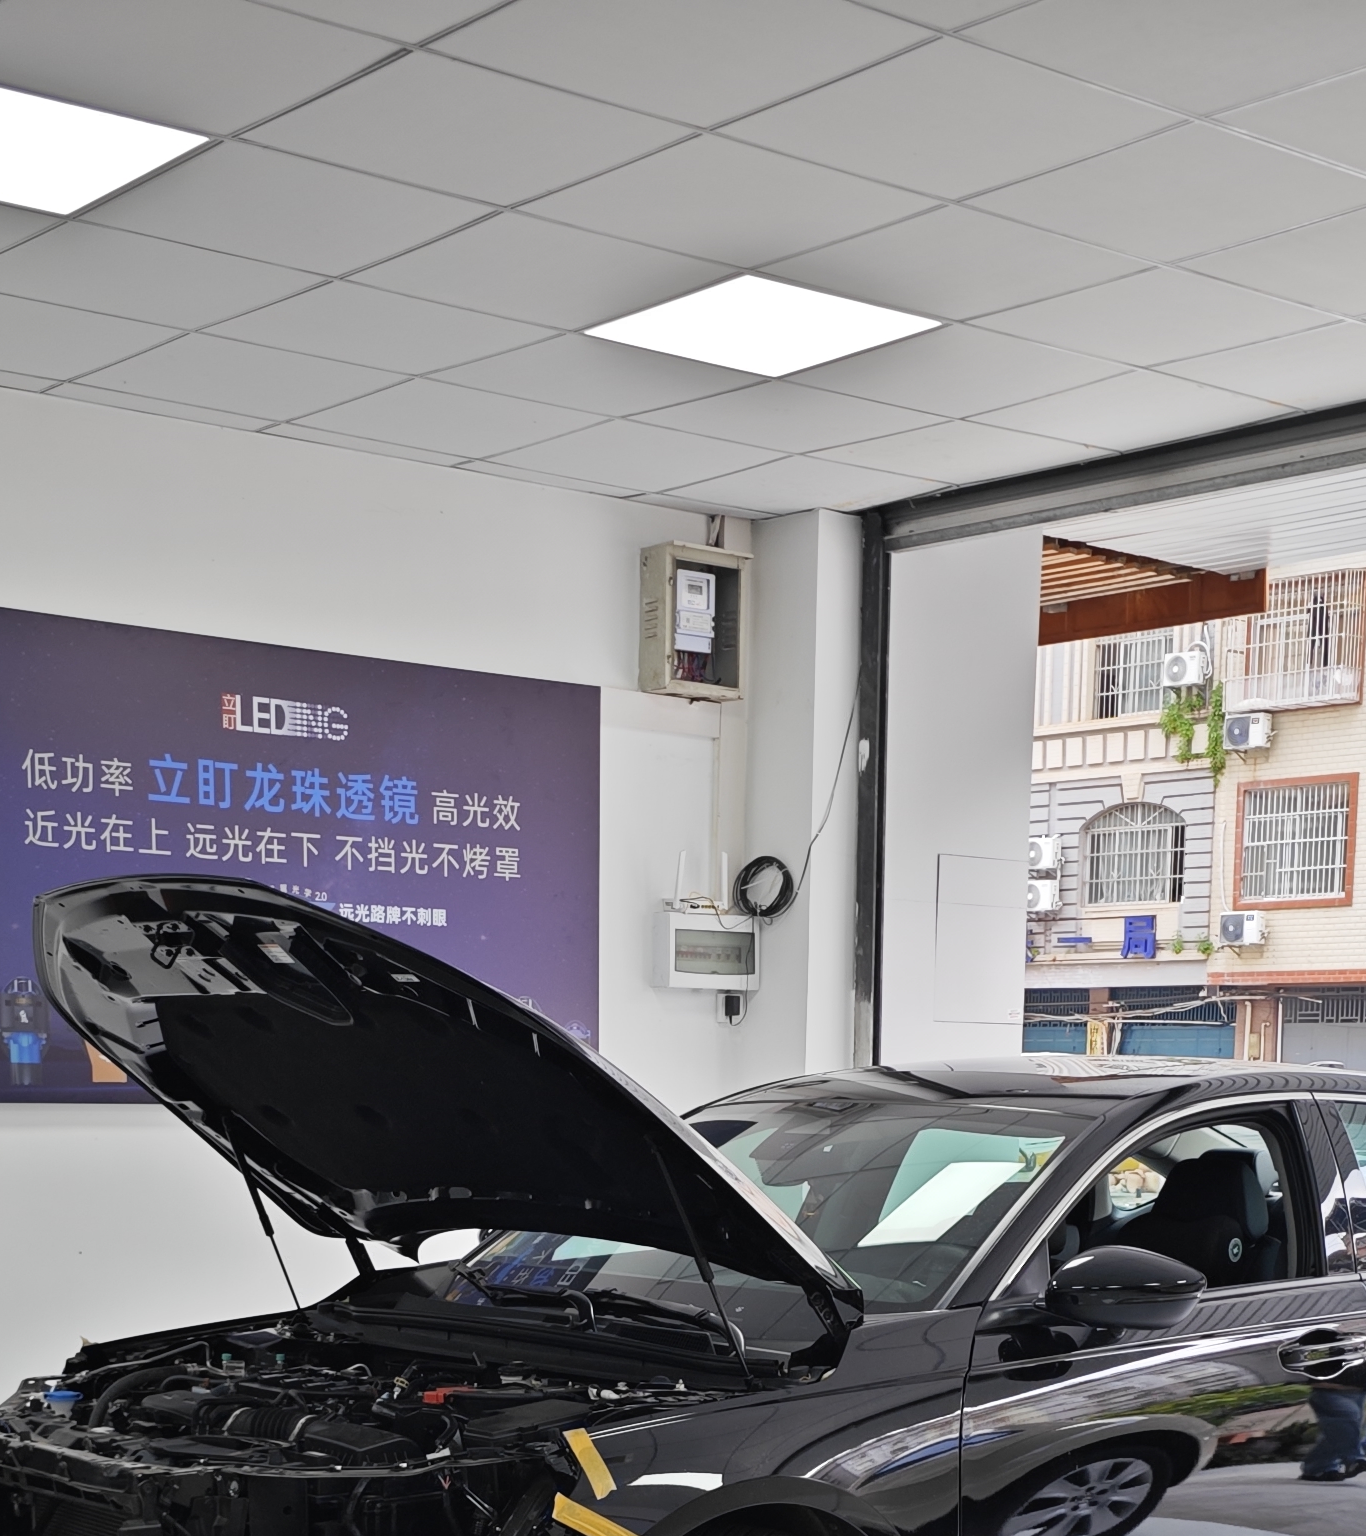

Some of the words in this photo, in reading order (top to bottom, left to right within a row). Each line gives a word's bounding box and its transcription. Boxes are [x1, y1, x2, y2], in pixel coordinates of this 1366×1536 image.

[21, 748, 134, 797] 低功率
[147, 753, 420, 826] 立盯龙珠透镜
[430, 789, 522, 832] 高光效
[23, 808, 173, 856] 近光在上
[185, 821, 322, 868] 远光在下
[334, 834, 522, 882] 不挡光不烤罩
[338, 902, 448, 928] 远光路牌不刺眼
